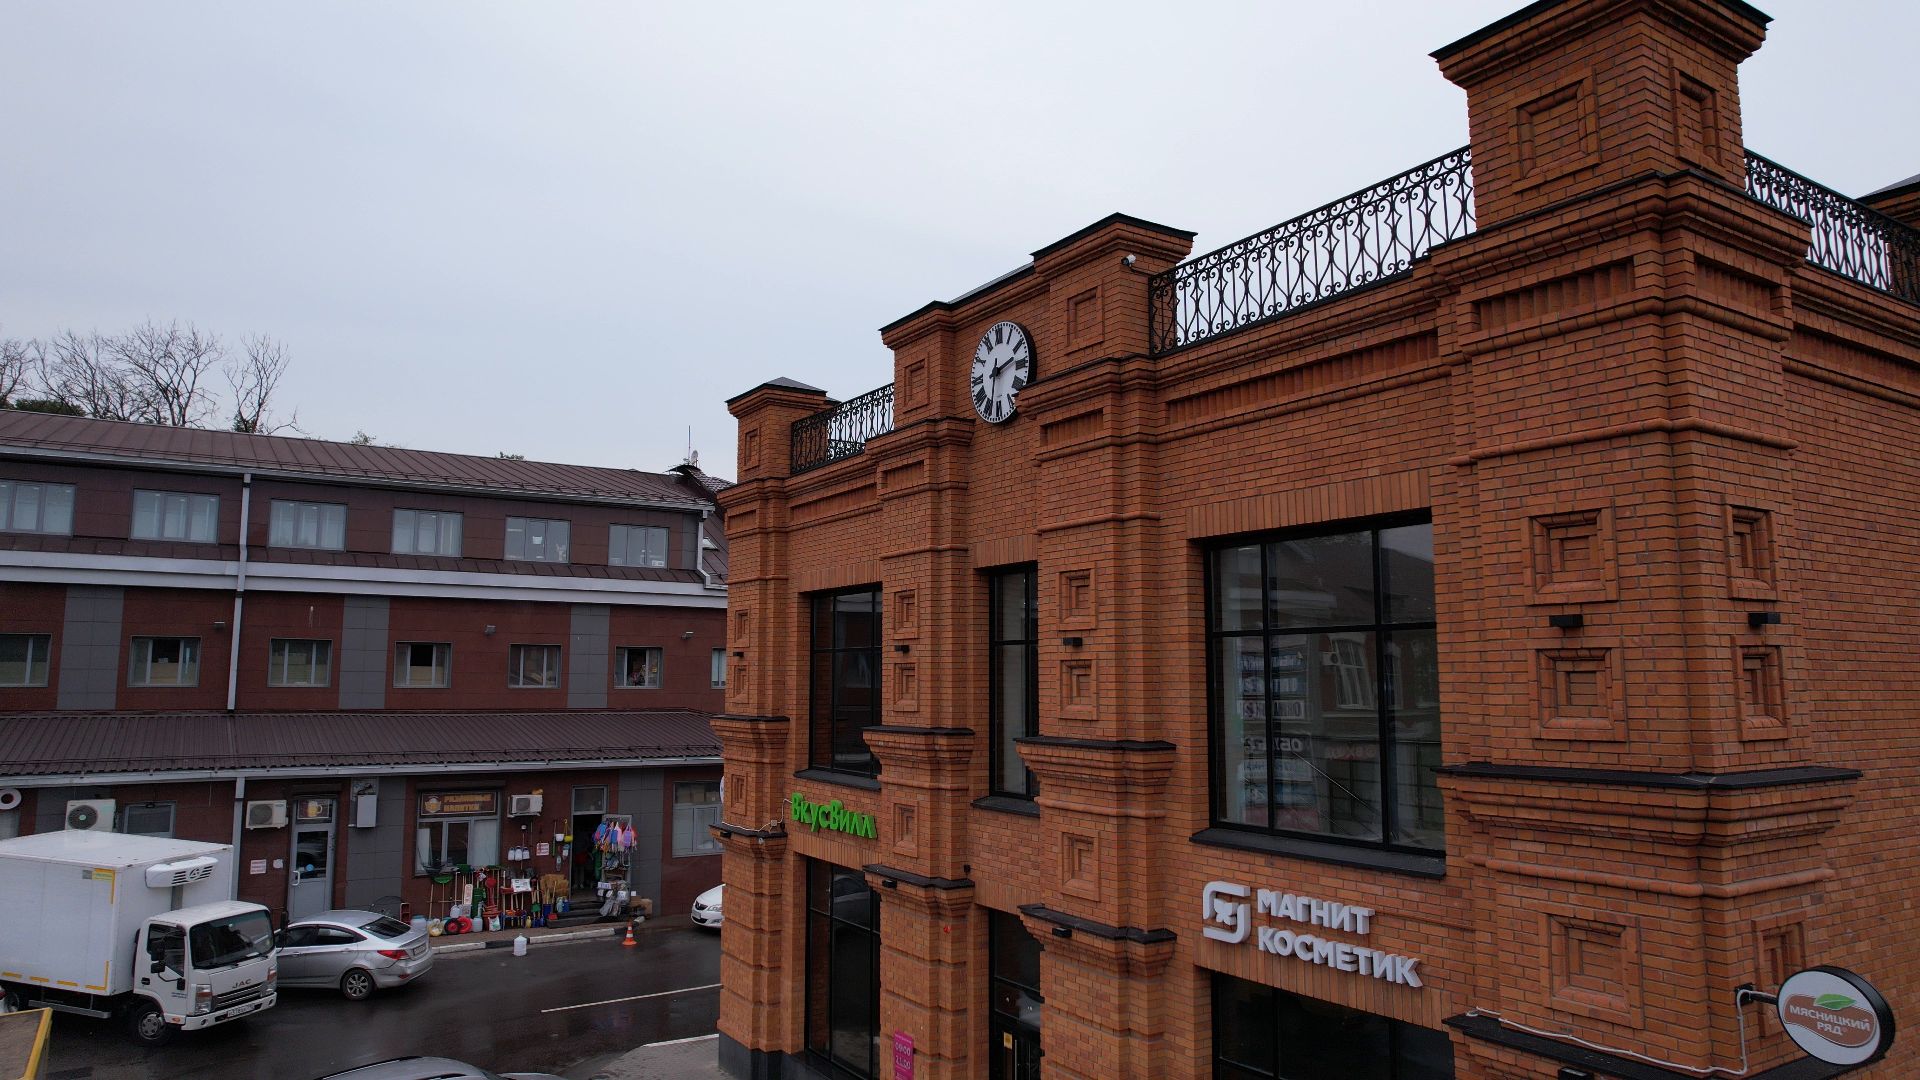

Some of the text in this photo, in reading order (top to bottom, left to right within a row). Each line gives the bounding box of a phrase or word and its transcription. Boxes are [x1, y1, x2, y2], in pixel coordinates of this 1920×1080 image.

[791, 793, 877, 838] ВкусВилл
[1257, 888, 1375, 935] МАГНИТ
[1257, 926, 1423, 988] КОСМЕТИК
[232, 978, 252, 989] JAC
[1790, 1005, 1870, 1031] МЯСНИЦКИЙ
[1816, 1021, 1843, 1036] РЯД
